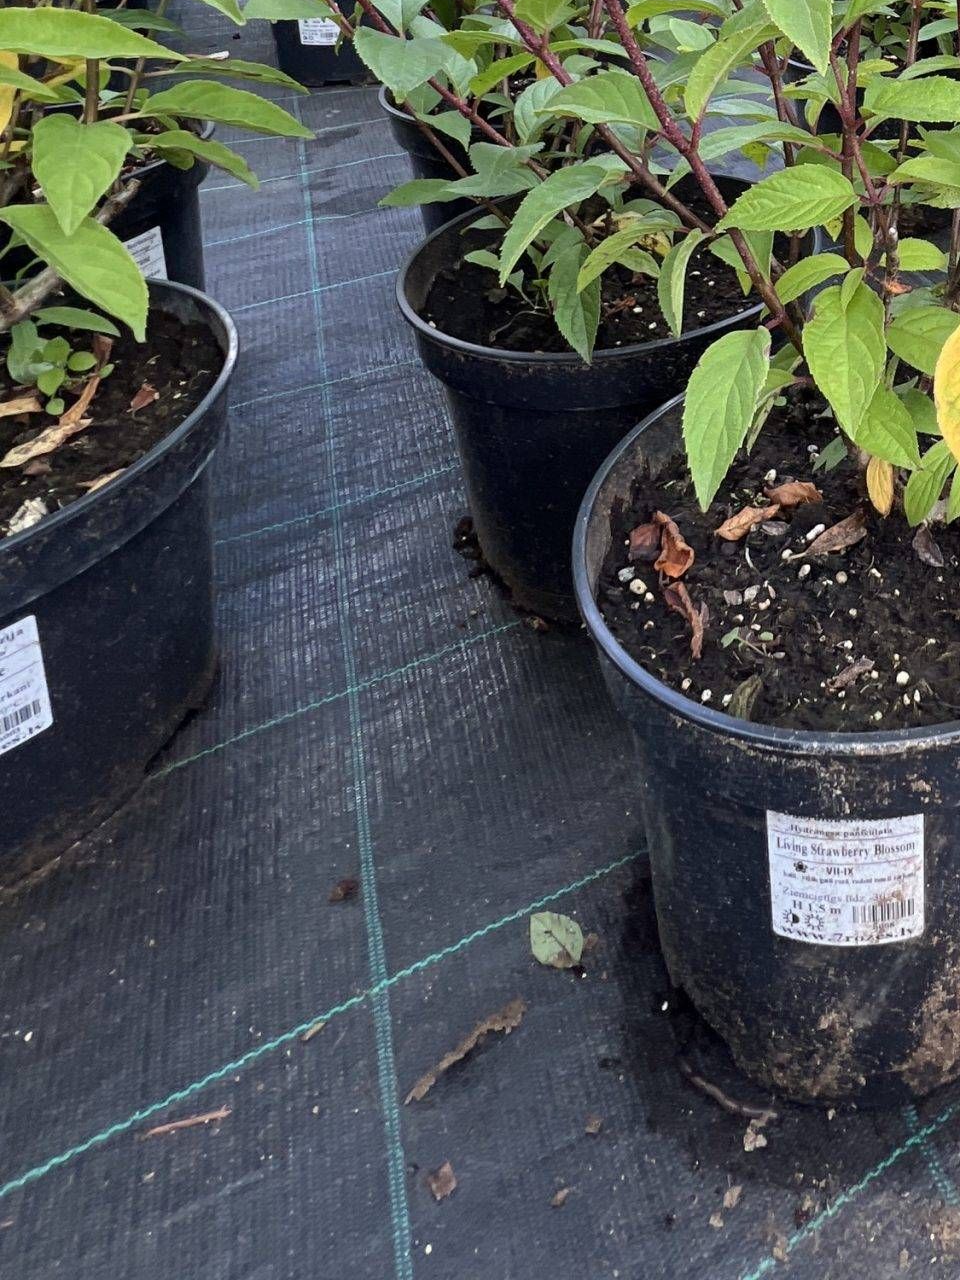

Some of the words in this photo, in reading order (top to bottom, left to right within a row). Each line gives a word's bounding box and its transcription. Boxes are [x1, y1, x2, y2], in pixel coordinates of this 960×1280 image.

[776, 837, 807, 856] Living
[811, 843, 869, 858] Strawberry
[874, 841, 915, 855] Blossom
[826, 867, 854, 876] VII-IX
[793, 900, 803, 910] H
